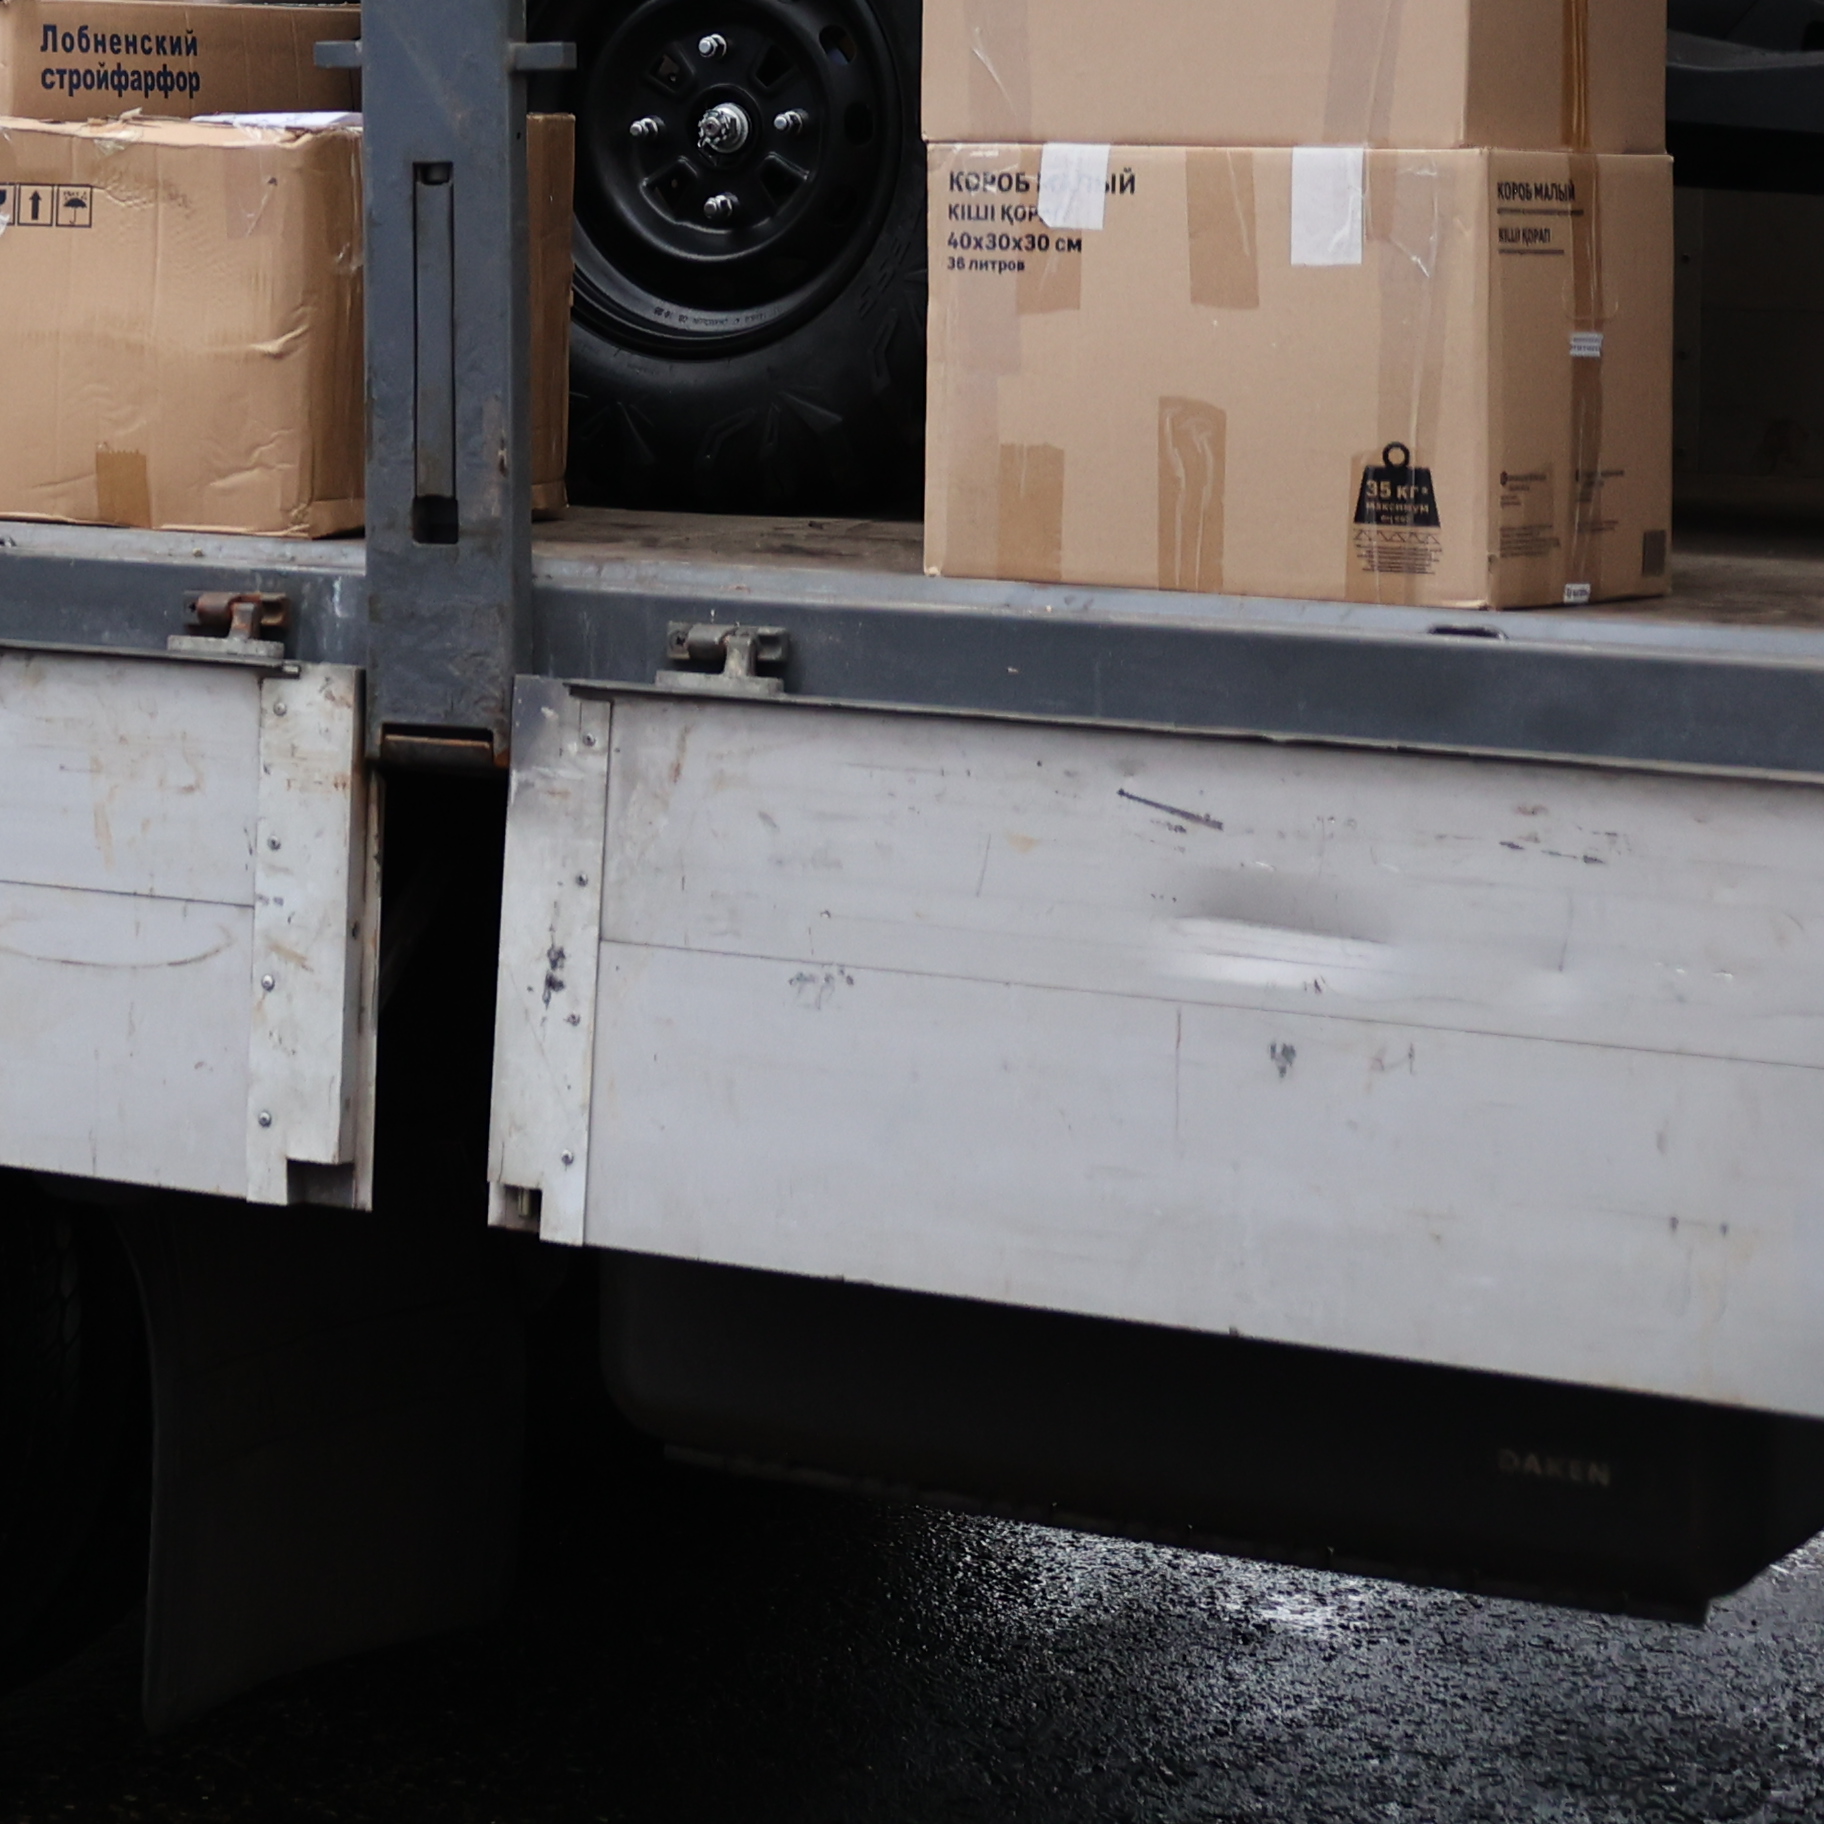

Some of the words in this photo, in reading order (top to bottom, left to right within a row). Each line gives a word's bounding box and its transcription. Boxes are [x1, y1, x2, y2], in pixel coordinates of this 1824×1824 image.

[40, 23, 198, 57] Лобненский
[40, 61, 201, 99] стройфарфор
[949, 170, 1031, 193] КОРОБ
[1497, 181, 1533, 202] КОРОБ
[1533, 180, 1576, 202] МАЛЫЙ
[1055, 236, 1082, 253] см
[947, 257, 965, 270] 36
[969, 258, 1025, 274] литров
[1366, 479, 1392, 498] 35
